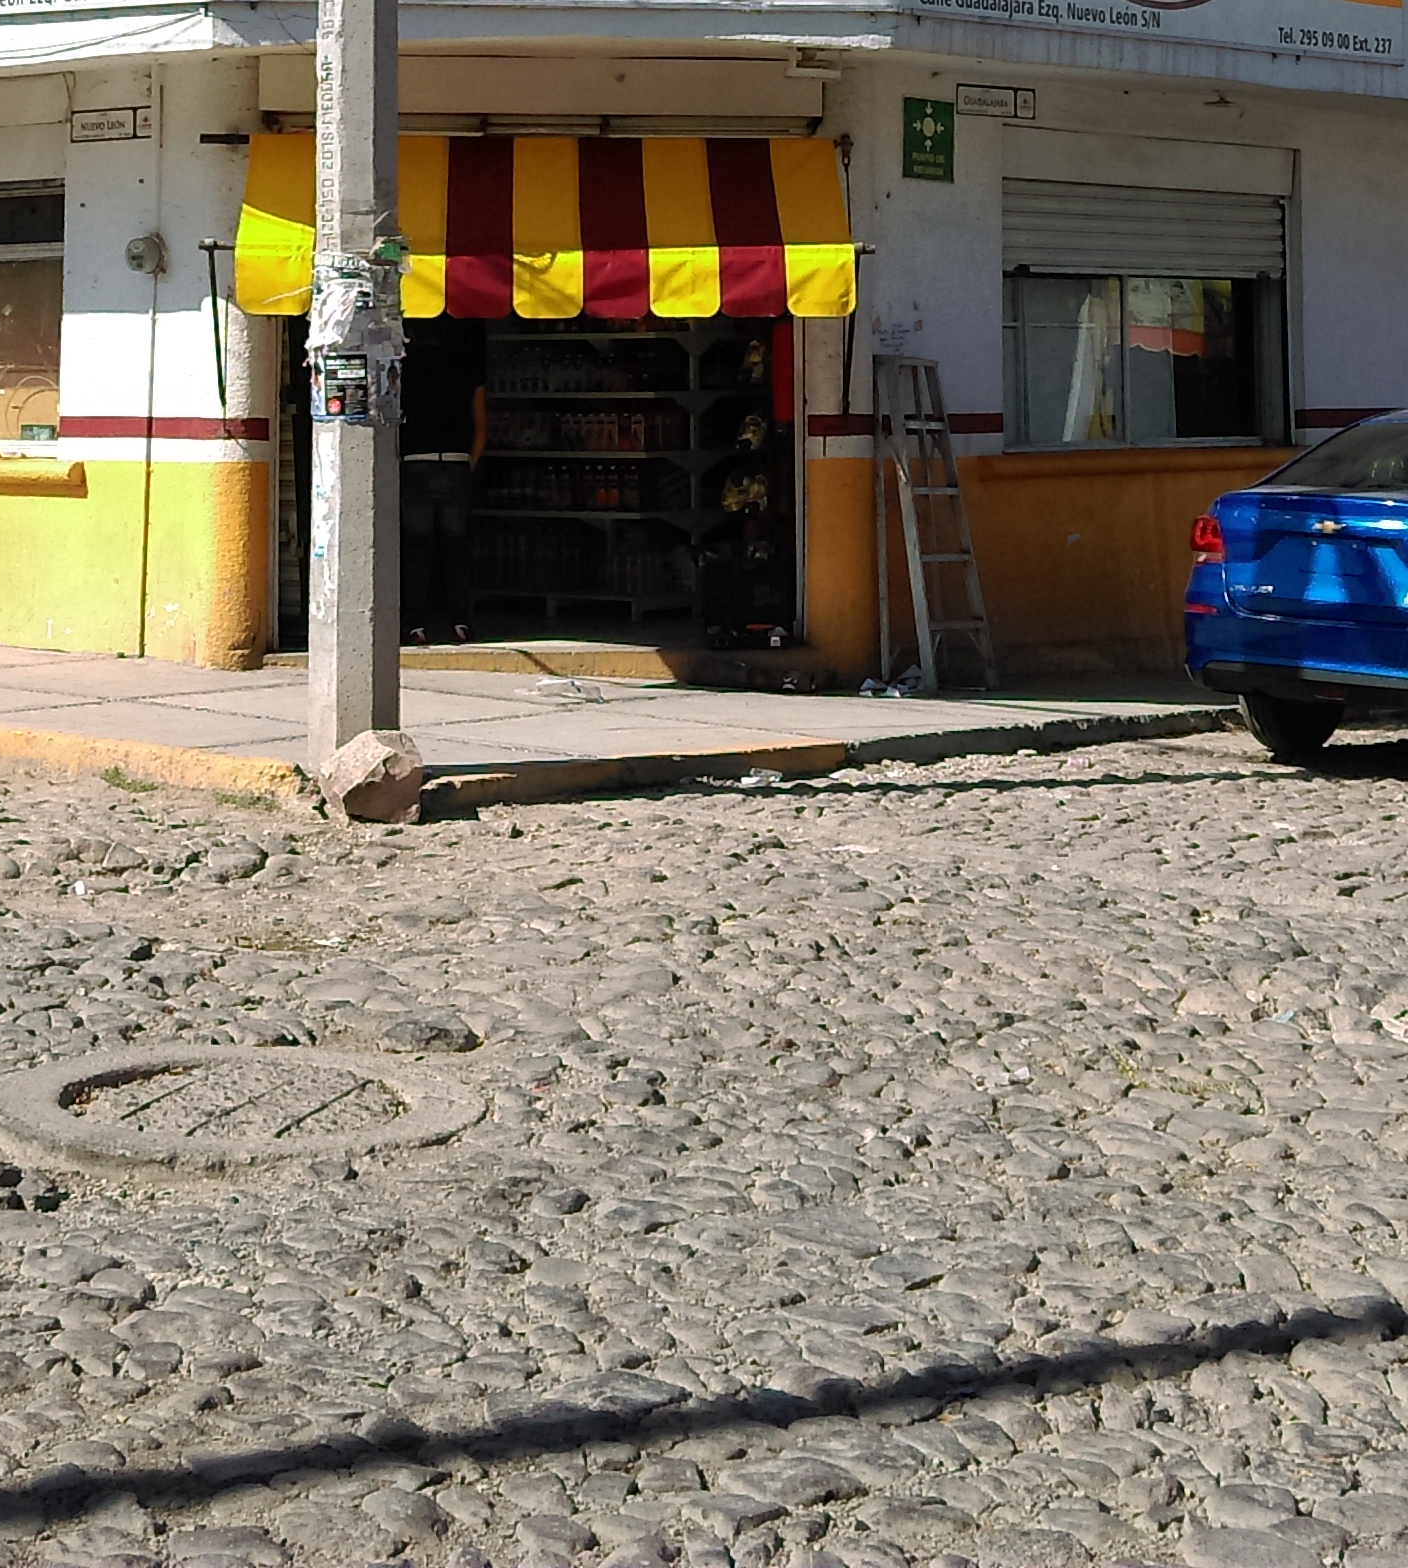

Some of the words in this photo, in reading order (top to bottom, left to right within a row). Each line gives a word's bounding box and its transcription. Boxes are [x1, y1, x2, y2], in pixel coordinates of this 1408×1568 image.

[1038, 0, 1063, 23] Ezq.
[1067, 2, 1106, 23] Nuevo
[1109, 6, 1138, 27] León
[1141, 10, 1161, 29] S/N
[1278, 26, 1296, 46] Tel.
[1299, 29, 1318, 47] 295
[1321, 31, 1334, 48] 09
[1337, 33, 1350, 50] 00
[1353, 35, 1371, 53] Ext.
[1374, 37, 1392, 55] 237
